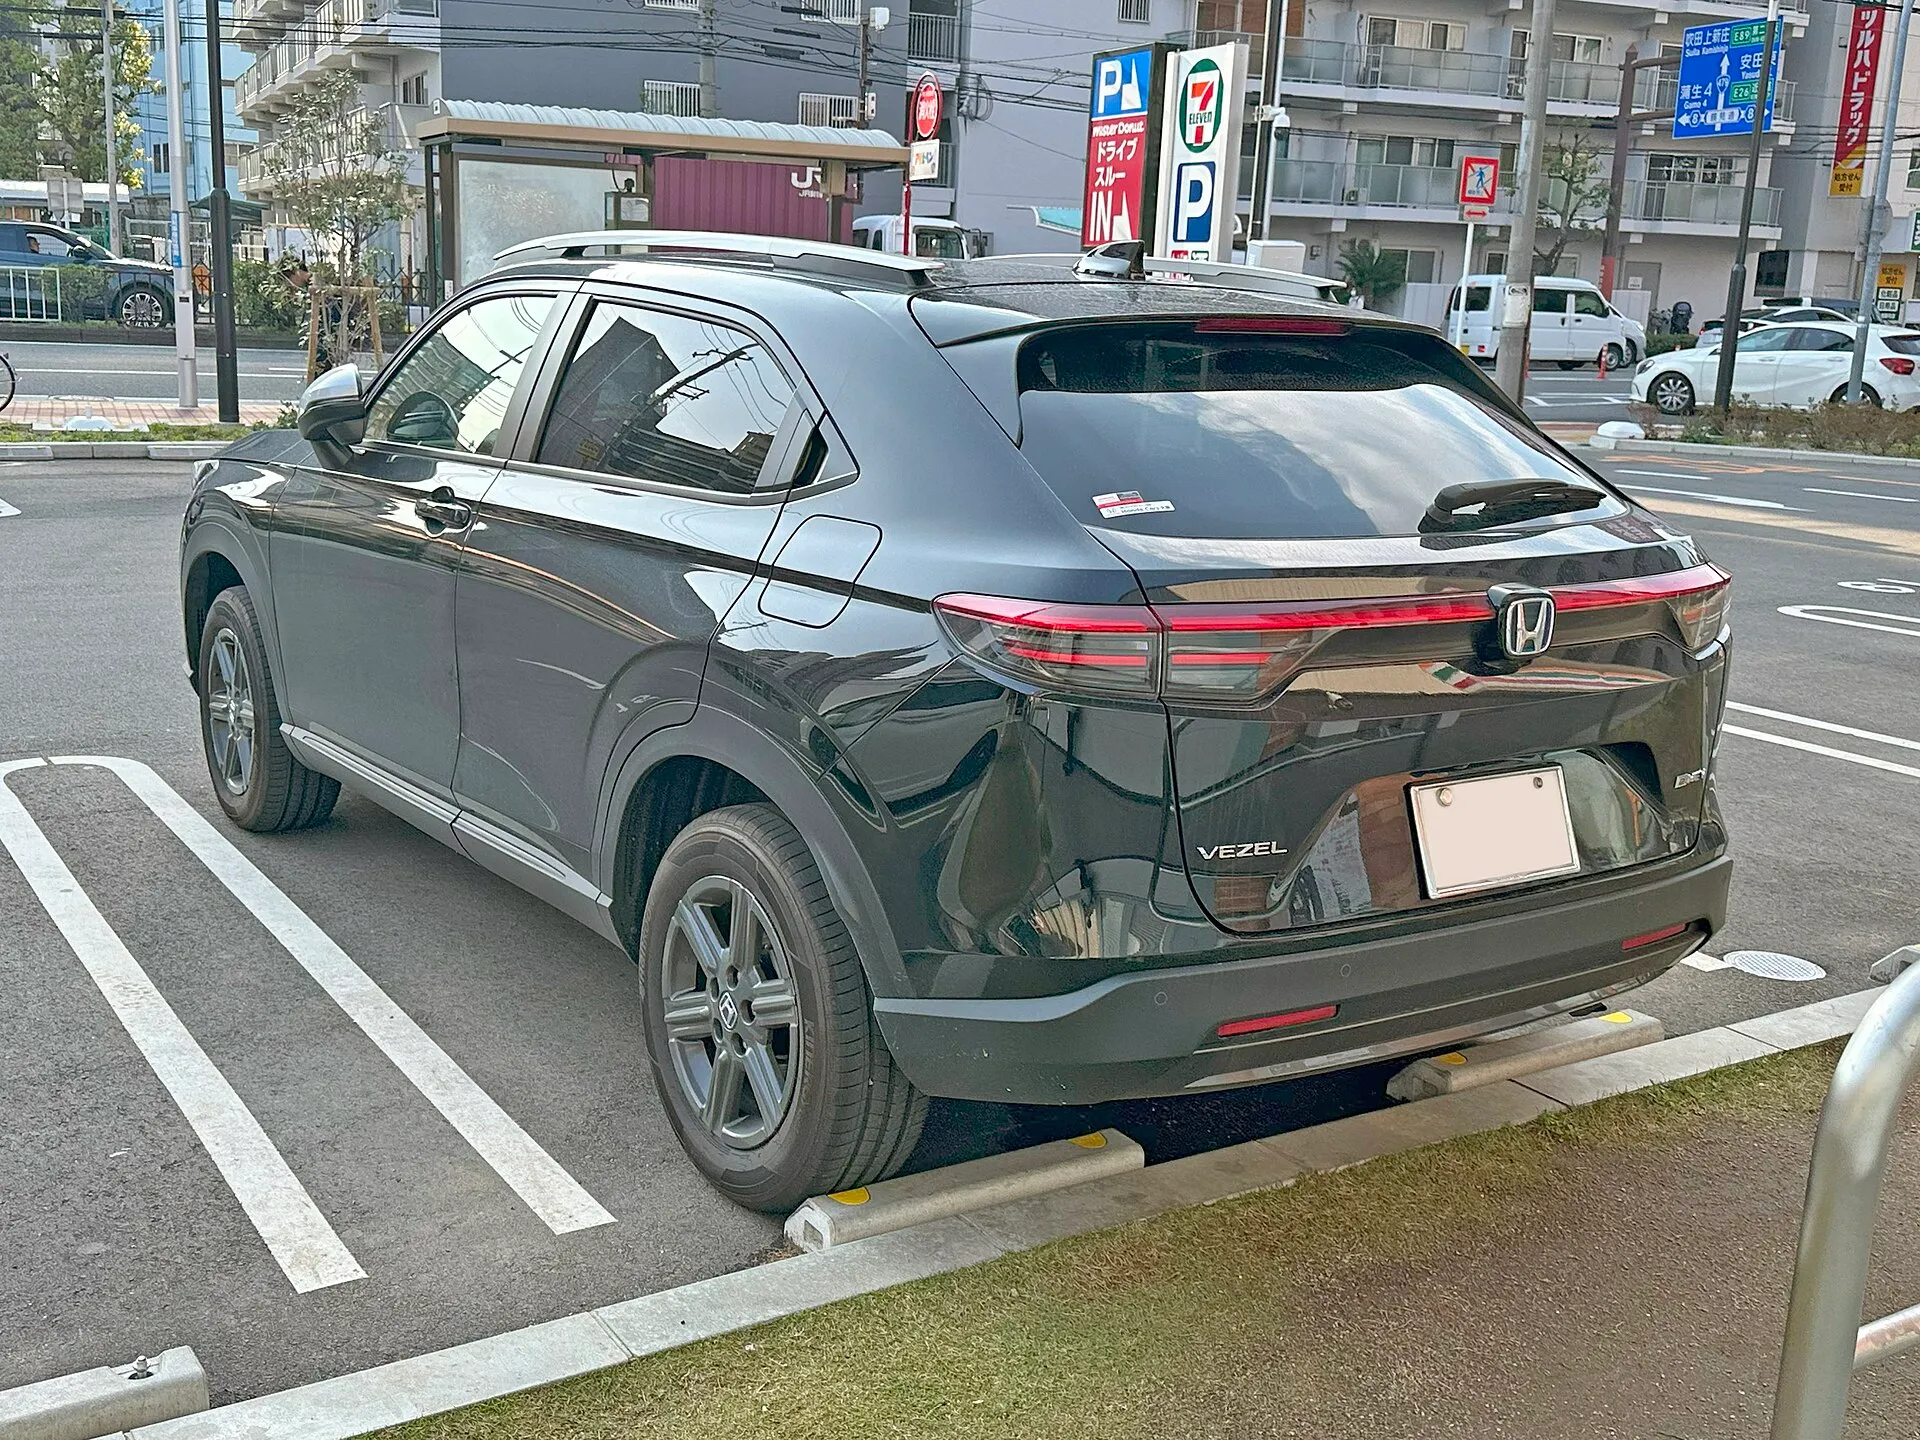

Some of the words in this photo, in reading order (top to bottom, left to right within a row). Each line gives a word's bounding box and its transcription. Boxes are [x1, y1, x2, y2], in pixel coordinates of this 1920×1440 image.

[1734, 31, 1751, 42] E89
[1098, 59, 1123, 114] P
[1845, 9, 1878, 147] ツルハドラッグ
[1734, 87, 1750, 98] E26
[1097, 137, 1138, 163] ドライブ
[1095, 165, 1126, 187] スルー
[1089, 190, 1113, 241] IN
[1177, 164, 1213, 241] P
[1196, 841, 1288, 860] VEZEL
